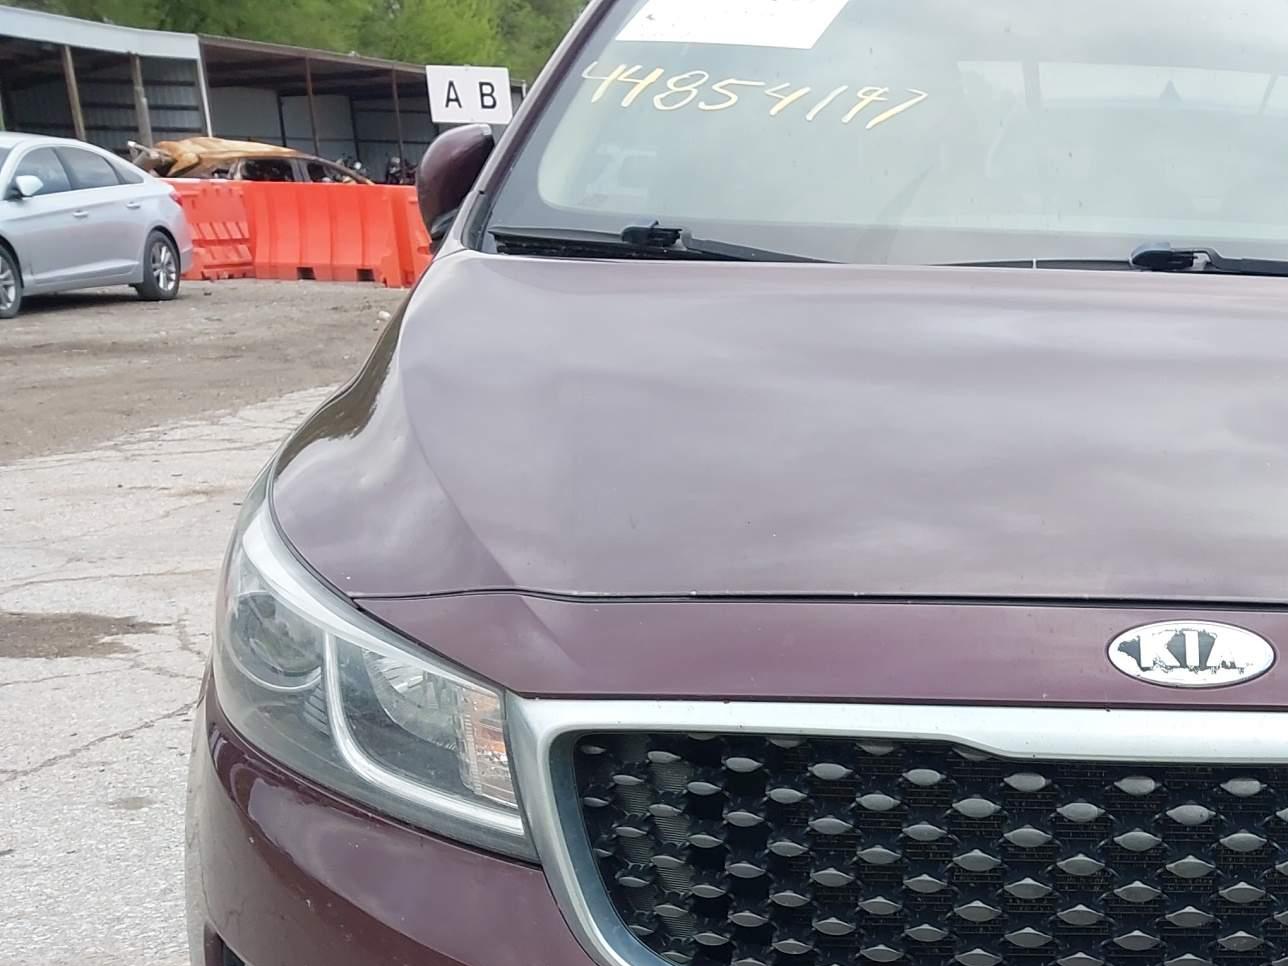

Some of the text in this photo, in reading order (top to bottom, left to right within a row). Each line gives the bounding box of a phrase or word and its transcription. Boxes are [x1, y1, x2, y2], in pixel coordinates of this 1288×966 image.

[445, 80, 497, 109] A B
[582, 61, 929, 129] 44854197
